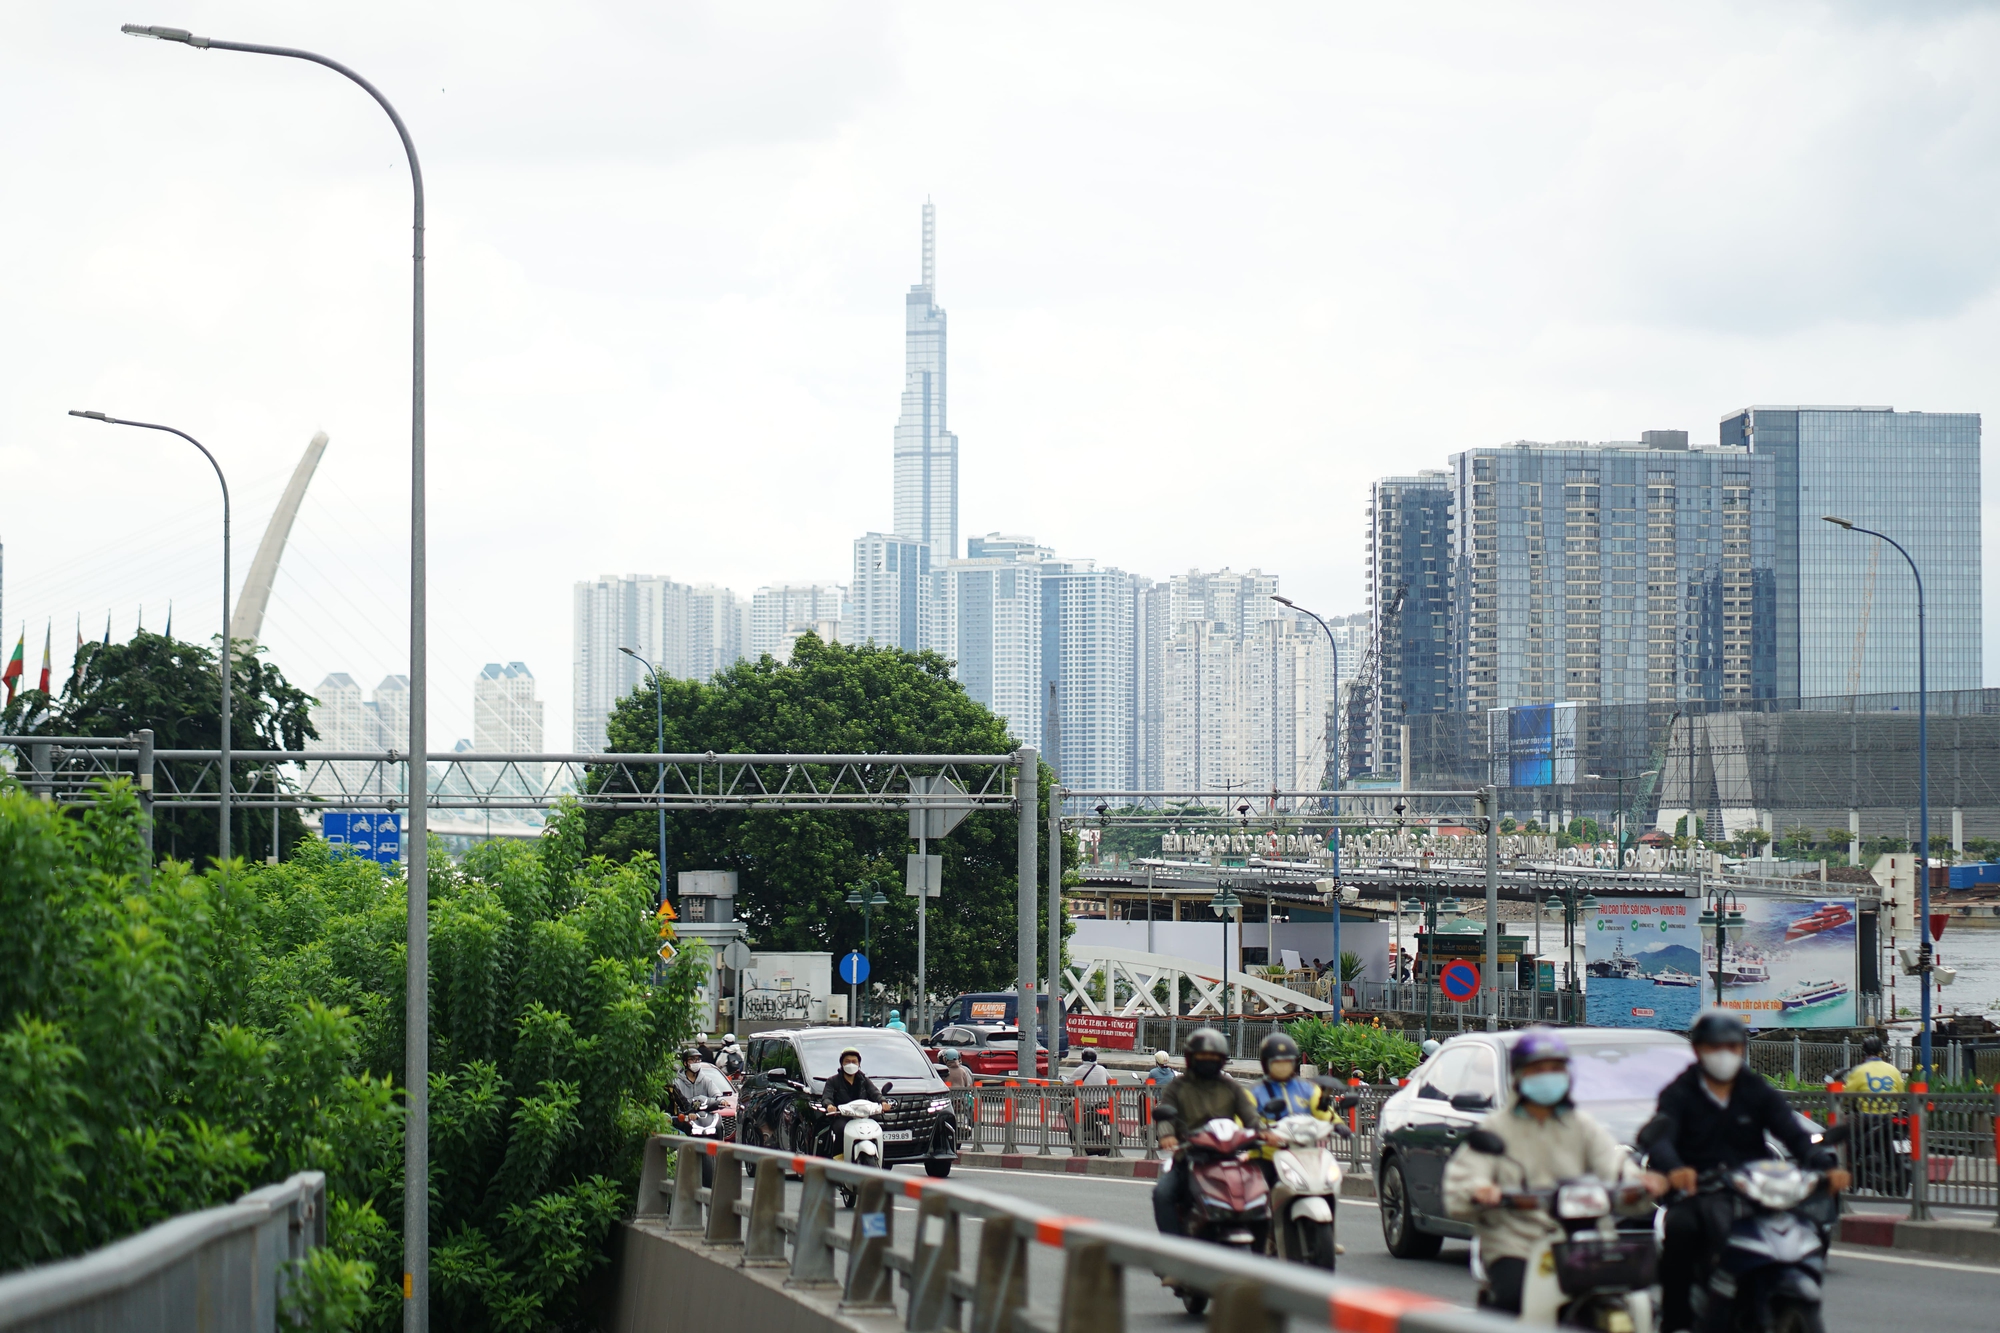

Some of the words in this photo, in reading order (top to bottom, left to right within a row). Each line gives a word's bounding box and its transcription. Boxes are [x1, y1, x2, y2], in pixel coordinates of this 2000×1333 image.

[1205, 834, 1230, 853] CAO
[1344, 834, 1380, 853] BACH
[1381, 834, 1418, 853] DANG
[1420, 833, 1459, 853] SPEED
[1460, 835, 1487, 854] FERR
[1608, 904, 1619, 914] CAO
[1620, 902, 1630, 915] TỐC
[978, 1004, 1005, 1012] LALAMOVE
[1865, 1072, 1894, 1093] be
